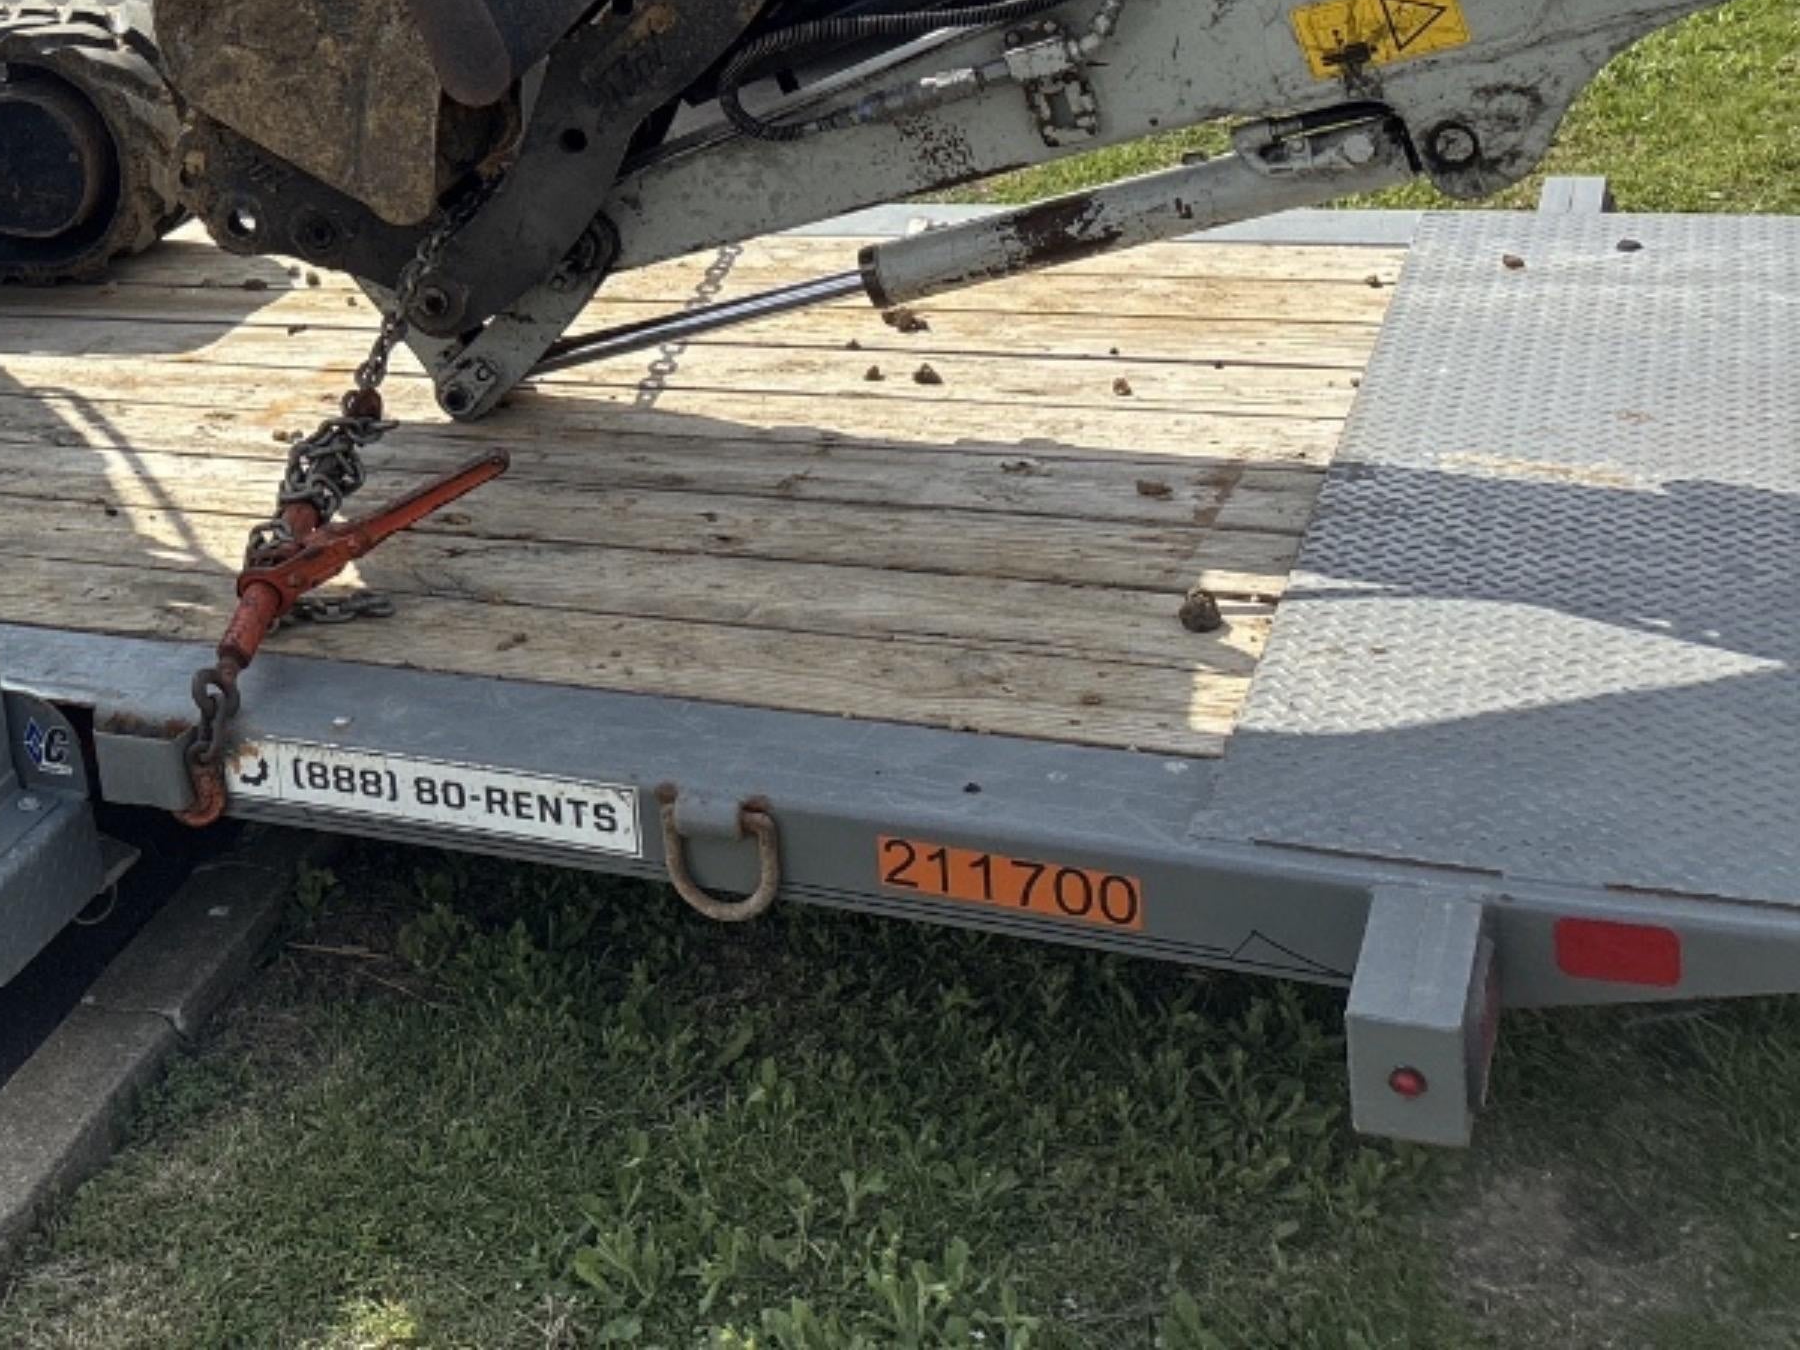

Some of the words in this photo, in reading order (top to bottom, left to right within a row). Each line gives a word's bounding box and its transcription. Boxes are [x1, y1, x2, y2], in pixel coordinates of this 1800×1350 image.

[292, 756, 398, 804] (888)
[413, 774, 620, 834] 80-RENTS
[882, 837, 1139, 926] 211700
